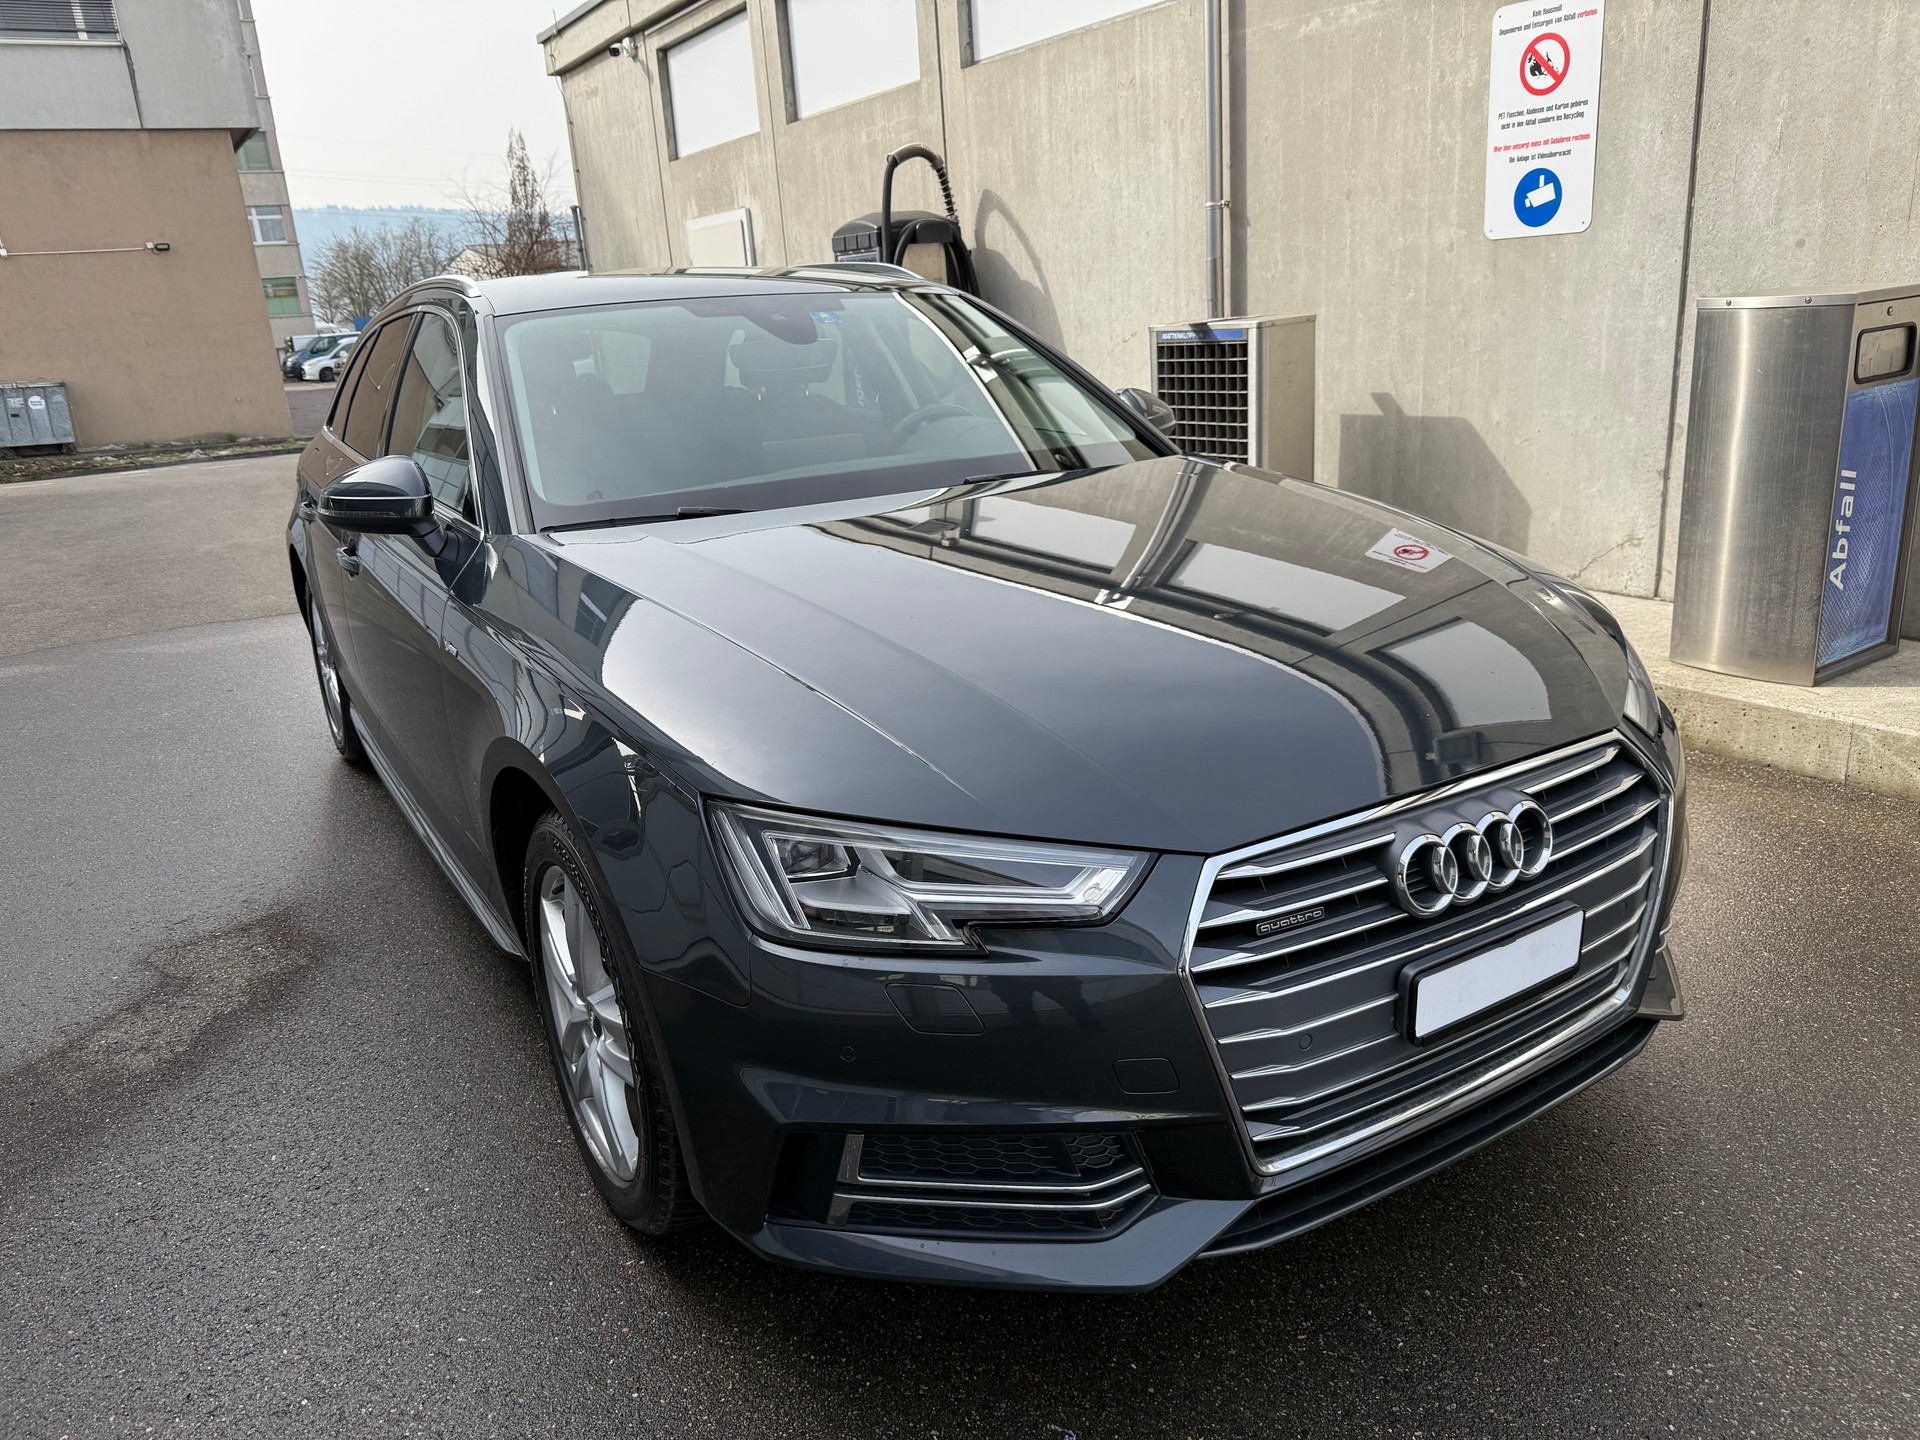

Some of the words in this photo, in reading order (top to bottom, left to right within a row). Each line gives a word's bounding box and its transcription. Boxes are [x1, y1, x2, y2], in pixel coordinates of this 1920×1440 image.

[1532, 18, 1554, 29] Entsorgen
[1563, 12, 1577, 22] Abfall
[1577, 8, 1598, 19] verboten
[1563, 110, 1585, 120] Recycling
[1829, 469, 1857, 591] Abfall
[1260, 910, 1322, 932] quattro
